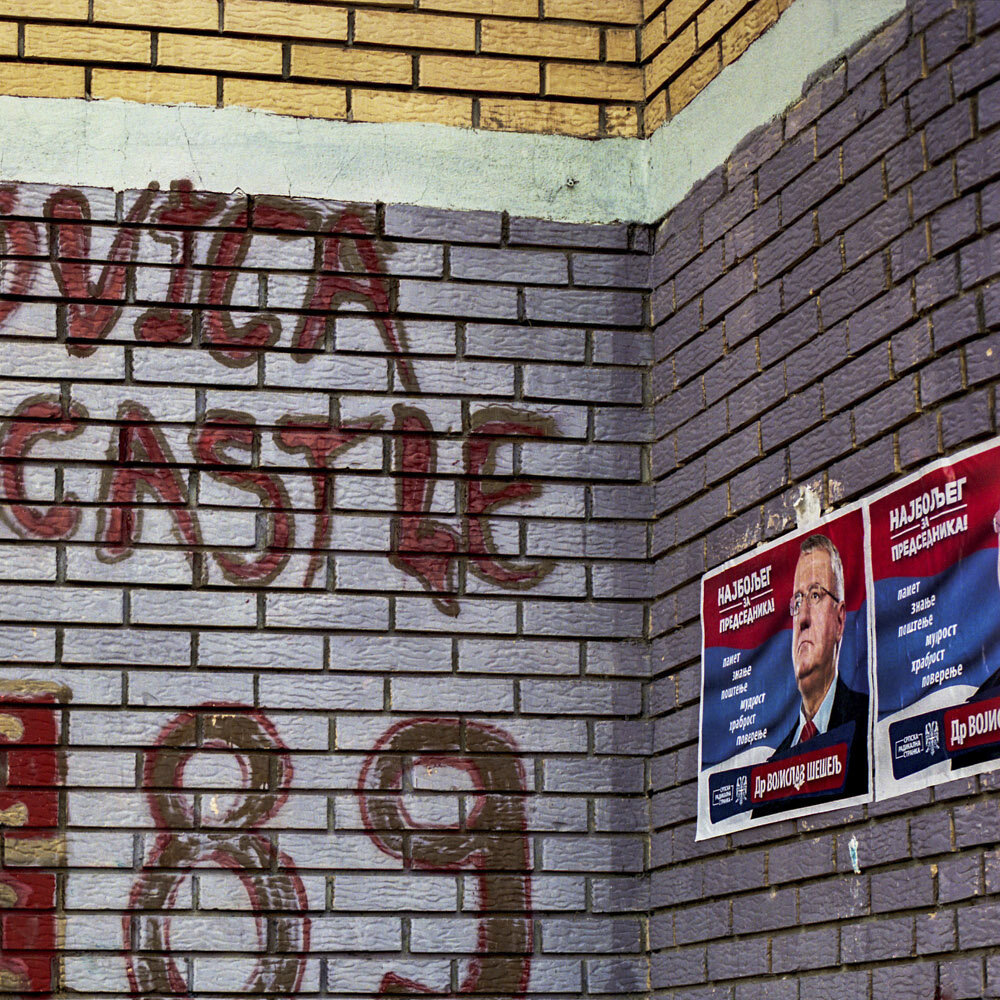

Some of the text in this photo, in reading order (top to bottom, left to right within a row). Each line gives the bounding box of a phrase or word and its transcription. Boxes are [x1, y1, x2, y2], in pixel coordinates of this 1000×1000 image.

[889, 476, 967, 532] НАЈБОЉЕГ
[920, 516, 930, 530] ЗА
[891, 514, 968, 562] ПРЕДСЕДНИКА!
[717, 565, 772, 607] НАЈБОЉЕГ
[897, 581, 921, 601] памет
[743, 596, 751, 608] ЗА
[911, 594, 936, 615] знање
[719, 597, 775, 634] ПРЕДСЕДНИКА!
[898, 613, 934, 638] поштење
[921, 663, 963, 688] поверење
[950, 719, 967, 746] Др
[753, 775, 766, 800] Др
[806, 754, 843, 782] ШЕШЕЉ
